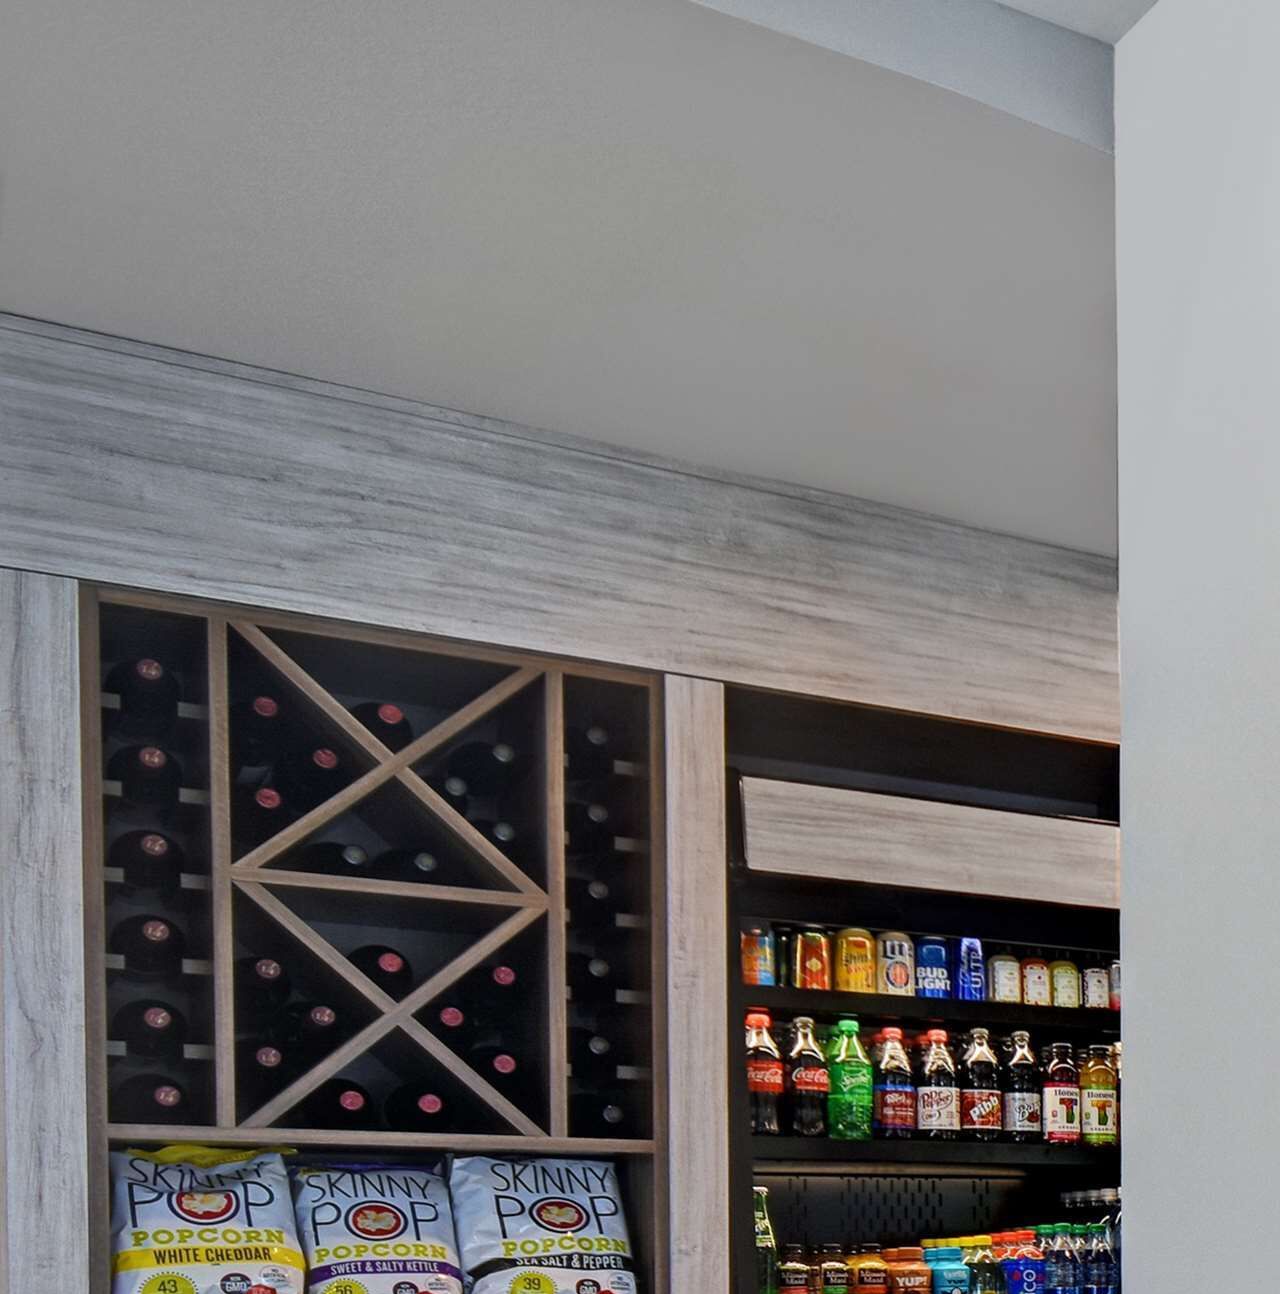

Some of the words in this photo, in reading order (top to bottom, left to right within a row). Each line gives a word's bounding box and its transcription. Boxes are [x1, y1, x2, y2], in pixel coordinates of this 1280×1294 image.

[917, 967, 948, 979] BUD
[490, 1160, 610, 1194] SKINNY
[305, 1172, 431, 1203] SKINNY
[128, 1181, 275, 1229] POP
[311, 1200, 439, 1246] POP
[494, 1195, 618, 1239] POP
[132, 1228, 285, 1247] POPCORN
[502, 1235, 627, 1257] POPCORN
[154, 1249, 201, 1264] WHITE
[205, 1247, 272, 1262] CHEDDAR
[315, 1243, 448, 1263] POPCORN
[541, 1255, 568, 1267] SALT
[571, 1255, 581, 1268] &
[583, 1255, 624, 1269] PEPPER
[331, 1263, 362, 1276] SWEET
[365, 1262, 374, 1272] &
[376, 1262, 404, 1273] SALTY
[406, 1262, 439, 1273] KETTLE
[157, 1279, 178, 1294] 43
[225, 1281, 249, 1291] GMO
[523, 1277, 541, 1290] 39
[896, 1276, 928, 1287] YUP!
